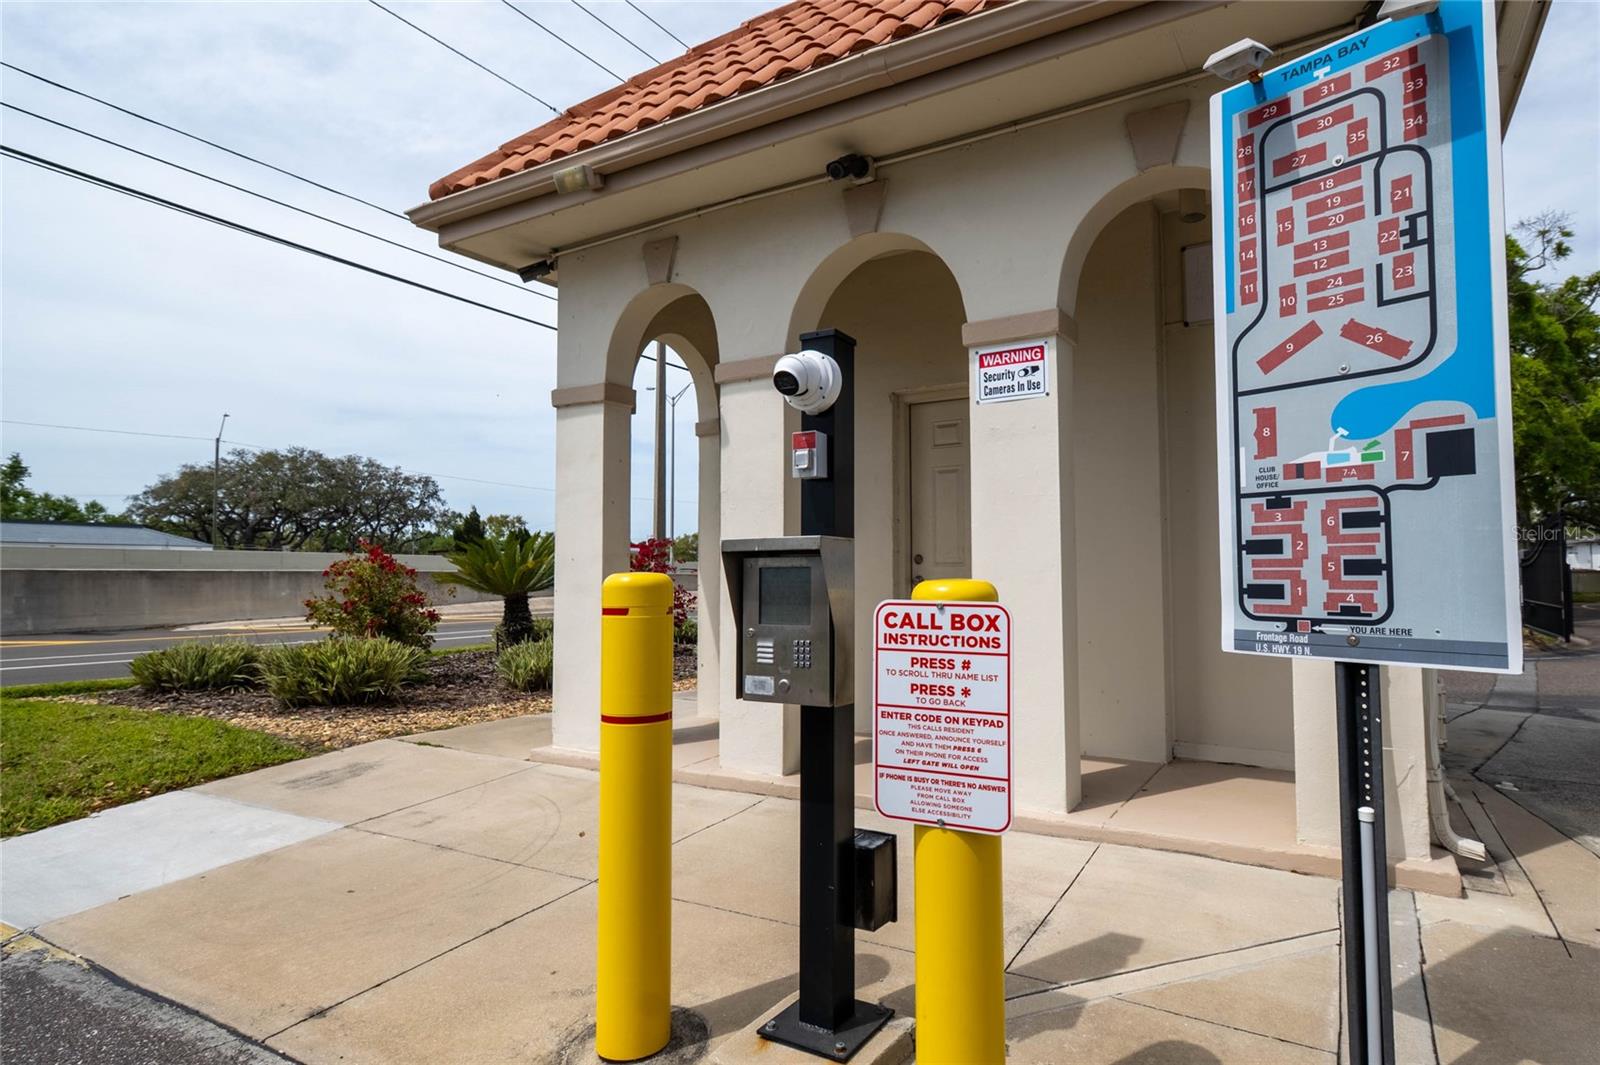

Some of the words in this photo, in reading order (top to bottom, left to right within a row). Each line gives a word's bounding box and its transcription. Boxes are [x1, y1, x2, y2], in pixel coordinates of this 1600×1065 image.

[1281, 53, 1333, 81] TAMPA
[1338, 36, 1370, 58] BAY
[1383, 57, 1401, 71] 32
[1321, 83, 1336, 96] 31
[1406, 78, 1424, 93] 33
[1263, 105, 1277, 118] 29
[1317, 117, 1333, 129] 30
[1406, 114, 1424, 128] 34
[1349, 130, 1366, 143] 35
[1238, 145, 1252, 157] 28
[1292, 155, 1307, 167] 27
[1240, 181, 1253, 192] 17
[1319, 178, 1334, 190] 18
[1393, 188, 1410, 201] 21
[1326, 196, 1341, 208] 19
[1241, 216, 1254, 226] 16
[1328, 214, 1345, 226] 20
[1278, 221, 1292, 232] 15
[1380, 231, 1398, 244] 22
[1313, 239, 1328, 251] 13
[1241, 249, 1254, 261] 14
[1313, 258, 1328, 270] 12
[1395, 265, 1413, 278] 23
[1327, 277, 1343, 288] 24
[1244, 284, 1254, 294] 11
[1281, 296, 1296, 307] 10
[1328, 295, 1344, 306] 25
[1366, 333, 1384, 345] 26
[1286, 342, 1294, 354] 9
[983, 348, 1042, 367] WARNING
[984, 369, 1016, 383] Security
[984, 384, 1016, 396] Cameras
[1018, 381, 1025, 392] In
[1027, 380, 1041, 391] Use
[1263, 427, 1270, 437] 8
[1402, 452, 1409, 462] 7
[1343, 468, 1357, 476] 7-A
[1274, 512, 1282, 522] 3
[1327, 516, 1335, 527] 6
[1296, 541, 1304, 550] 2
[1328, 562, 1335, 572] 5
[1297, 587, 1302, 596] 1
[1346, 594, 1355, 603] 4
[884, 612, 943, 630] CALL
[951, 614, 1001, 632] BOX
[1256, 632, 1288, 643] Frontage
[1289, 634, 1309, 644] Road
[1389, 628, 1413, 636] HERE
[884, 633, 1001, 649] INSTRUCTIONS
[1256, 643, 1269, 653] U.S.
[1272, 645, 1290, 654] HWY.
[1293, 646, 1302, 655] 19
[1304, 647, 1313, 656] N.
[911, 657, 956, 670] PRESS
[961, 660, 971, 671] #
[898, 670, 929, 678] SCROLL
[955, 673, 979, 681] NAME
[981, 674, 998, 682] LIST
[911, 684, 955, 697] PRESS
[944, 699, 966, 707] BACK
[881, 711, 912, 721] ENTER
[914, 714, 942, 724] CODE
[945, 716, 960, 725] ON
[962, 717, 1004, 729] KEYPAD
[897, 732, 934, 740] ANSWERED,
[935, 735, 970, 744] ANNOUNCE
[973, 738, 1006, 746] YOURSELF
[925, 751, 946, 759] PHONE
[963, 755, 988, 763] ACCESS
[886, 773, 906, 781] PHONE
[941, 780, 966, 788] THERE'S
[978, 784, 1006, 793] ANSWER
[910, 800, 942, 808] ALLOWING
[944, 804, 973, 812] SOMEONE
[927, 810, 971, 819] ACCESSIBILITY
